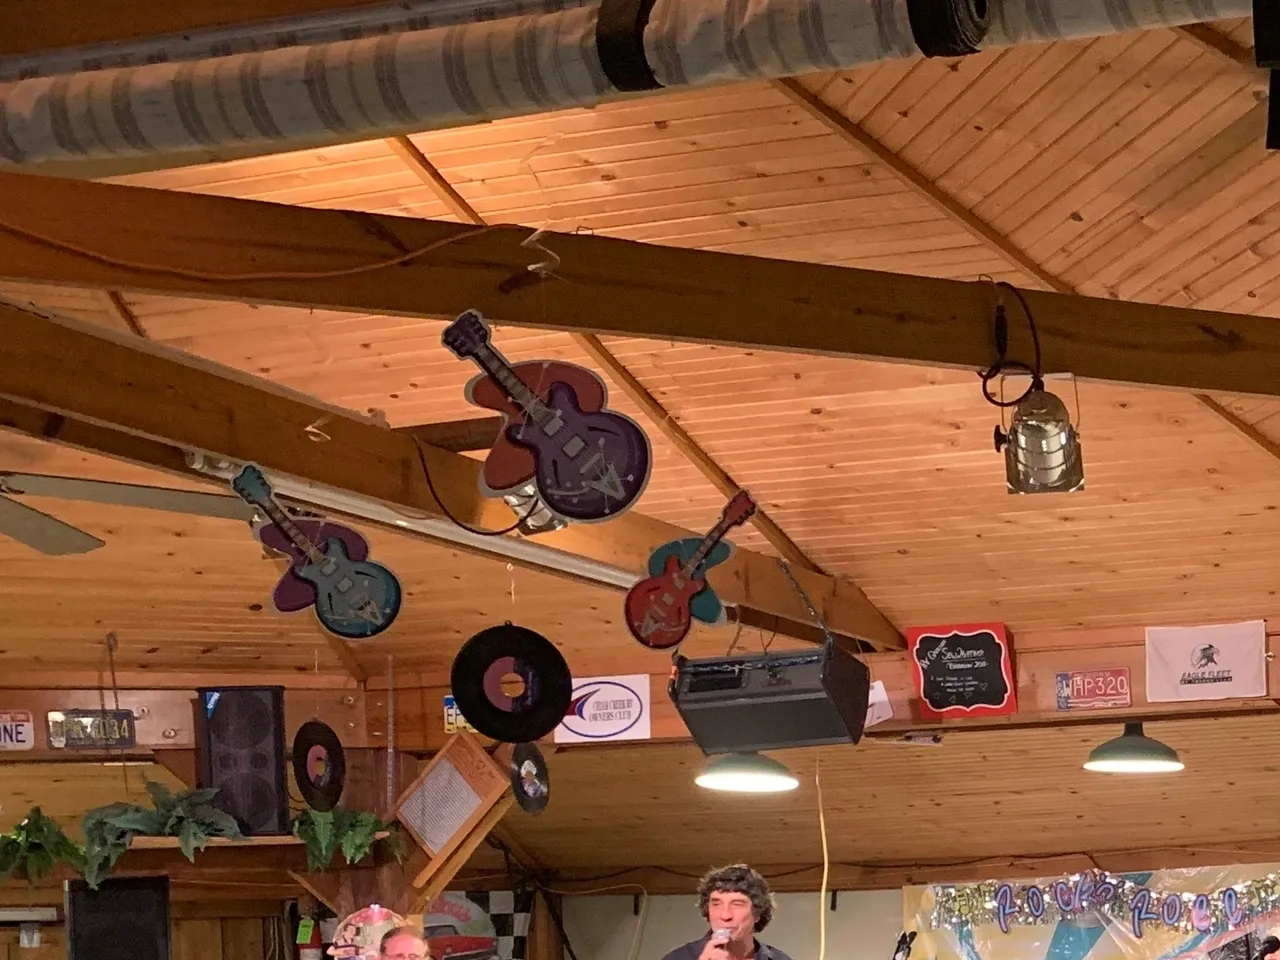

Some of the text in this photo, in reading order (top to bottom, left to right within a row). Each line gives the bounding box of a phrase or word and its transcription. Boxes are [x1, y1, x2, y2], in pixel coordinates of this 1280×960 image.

[1181, 669, 1231, 680] EAGLE FLEET
[589, 711, 632, 722] OWNERS CLUB
